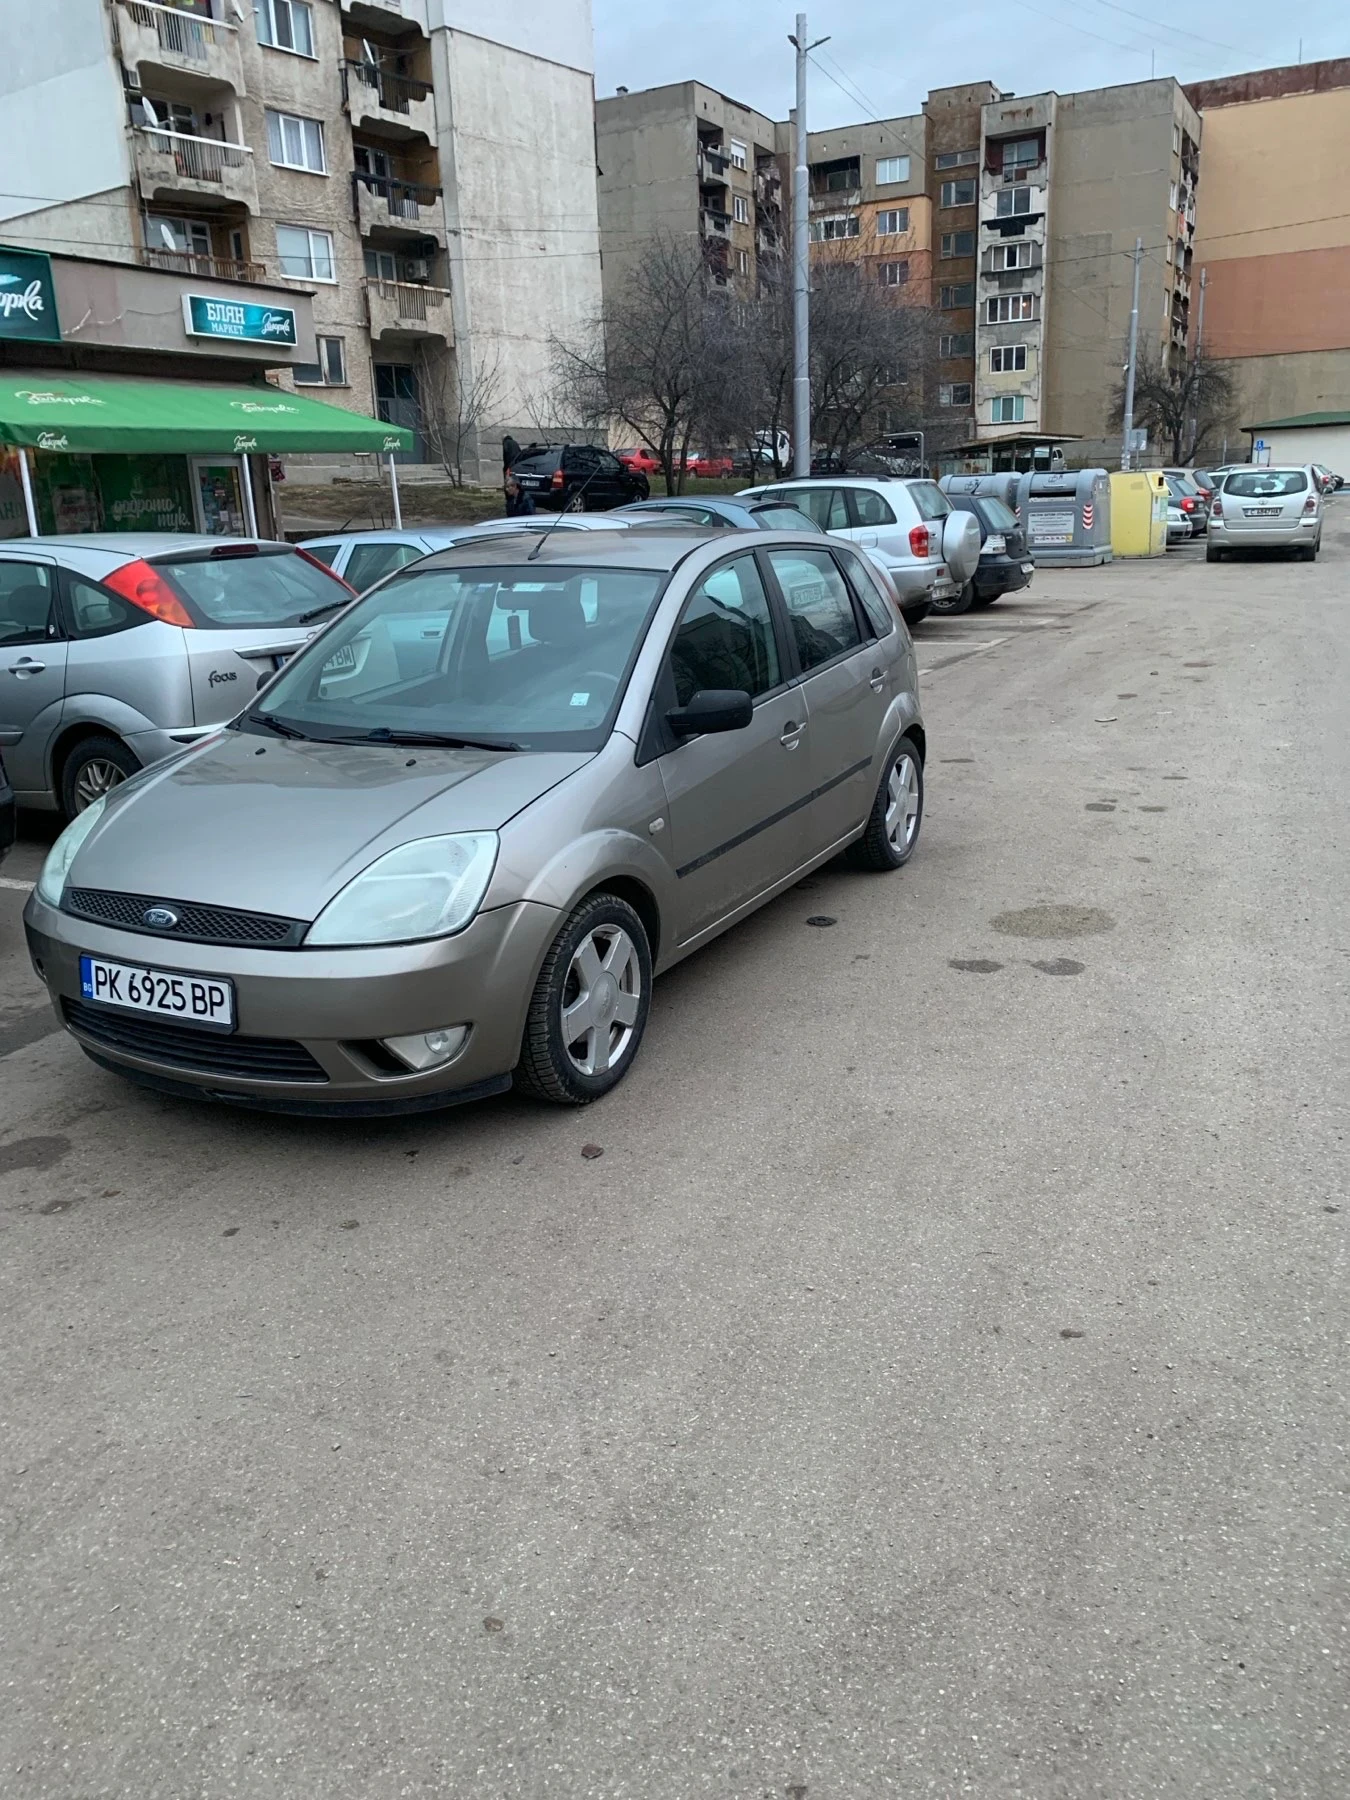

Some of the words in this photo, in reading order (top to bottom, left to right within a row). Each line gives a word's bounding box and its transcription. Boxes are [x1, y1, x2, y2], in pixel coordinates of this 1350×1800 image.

[206, 302, 245, 325] БЛЯН
[211, 322, 244, 335] МАРКЕТ
[148, 911, 171, 924] Ford
[83, 981, 92, 993] BG
[95, 965, 122, 1000] PK
[128, 972, 186, 1011] 6925
[190, 982, 224, 1016] BP
